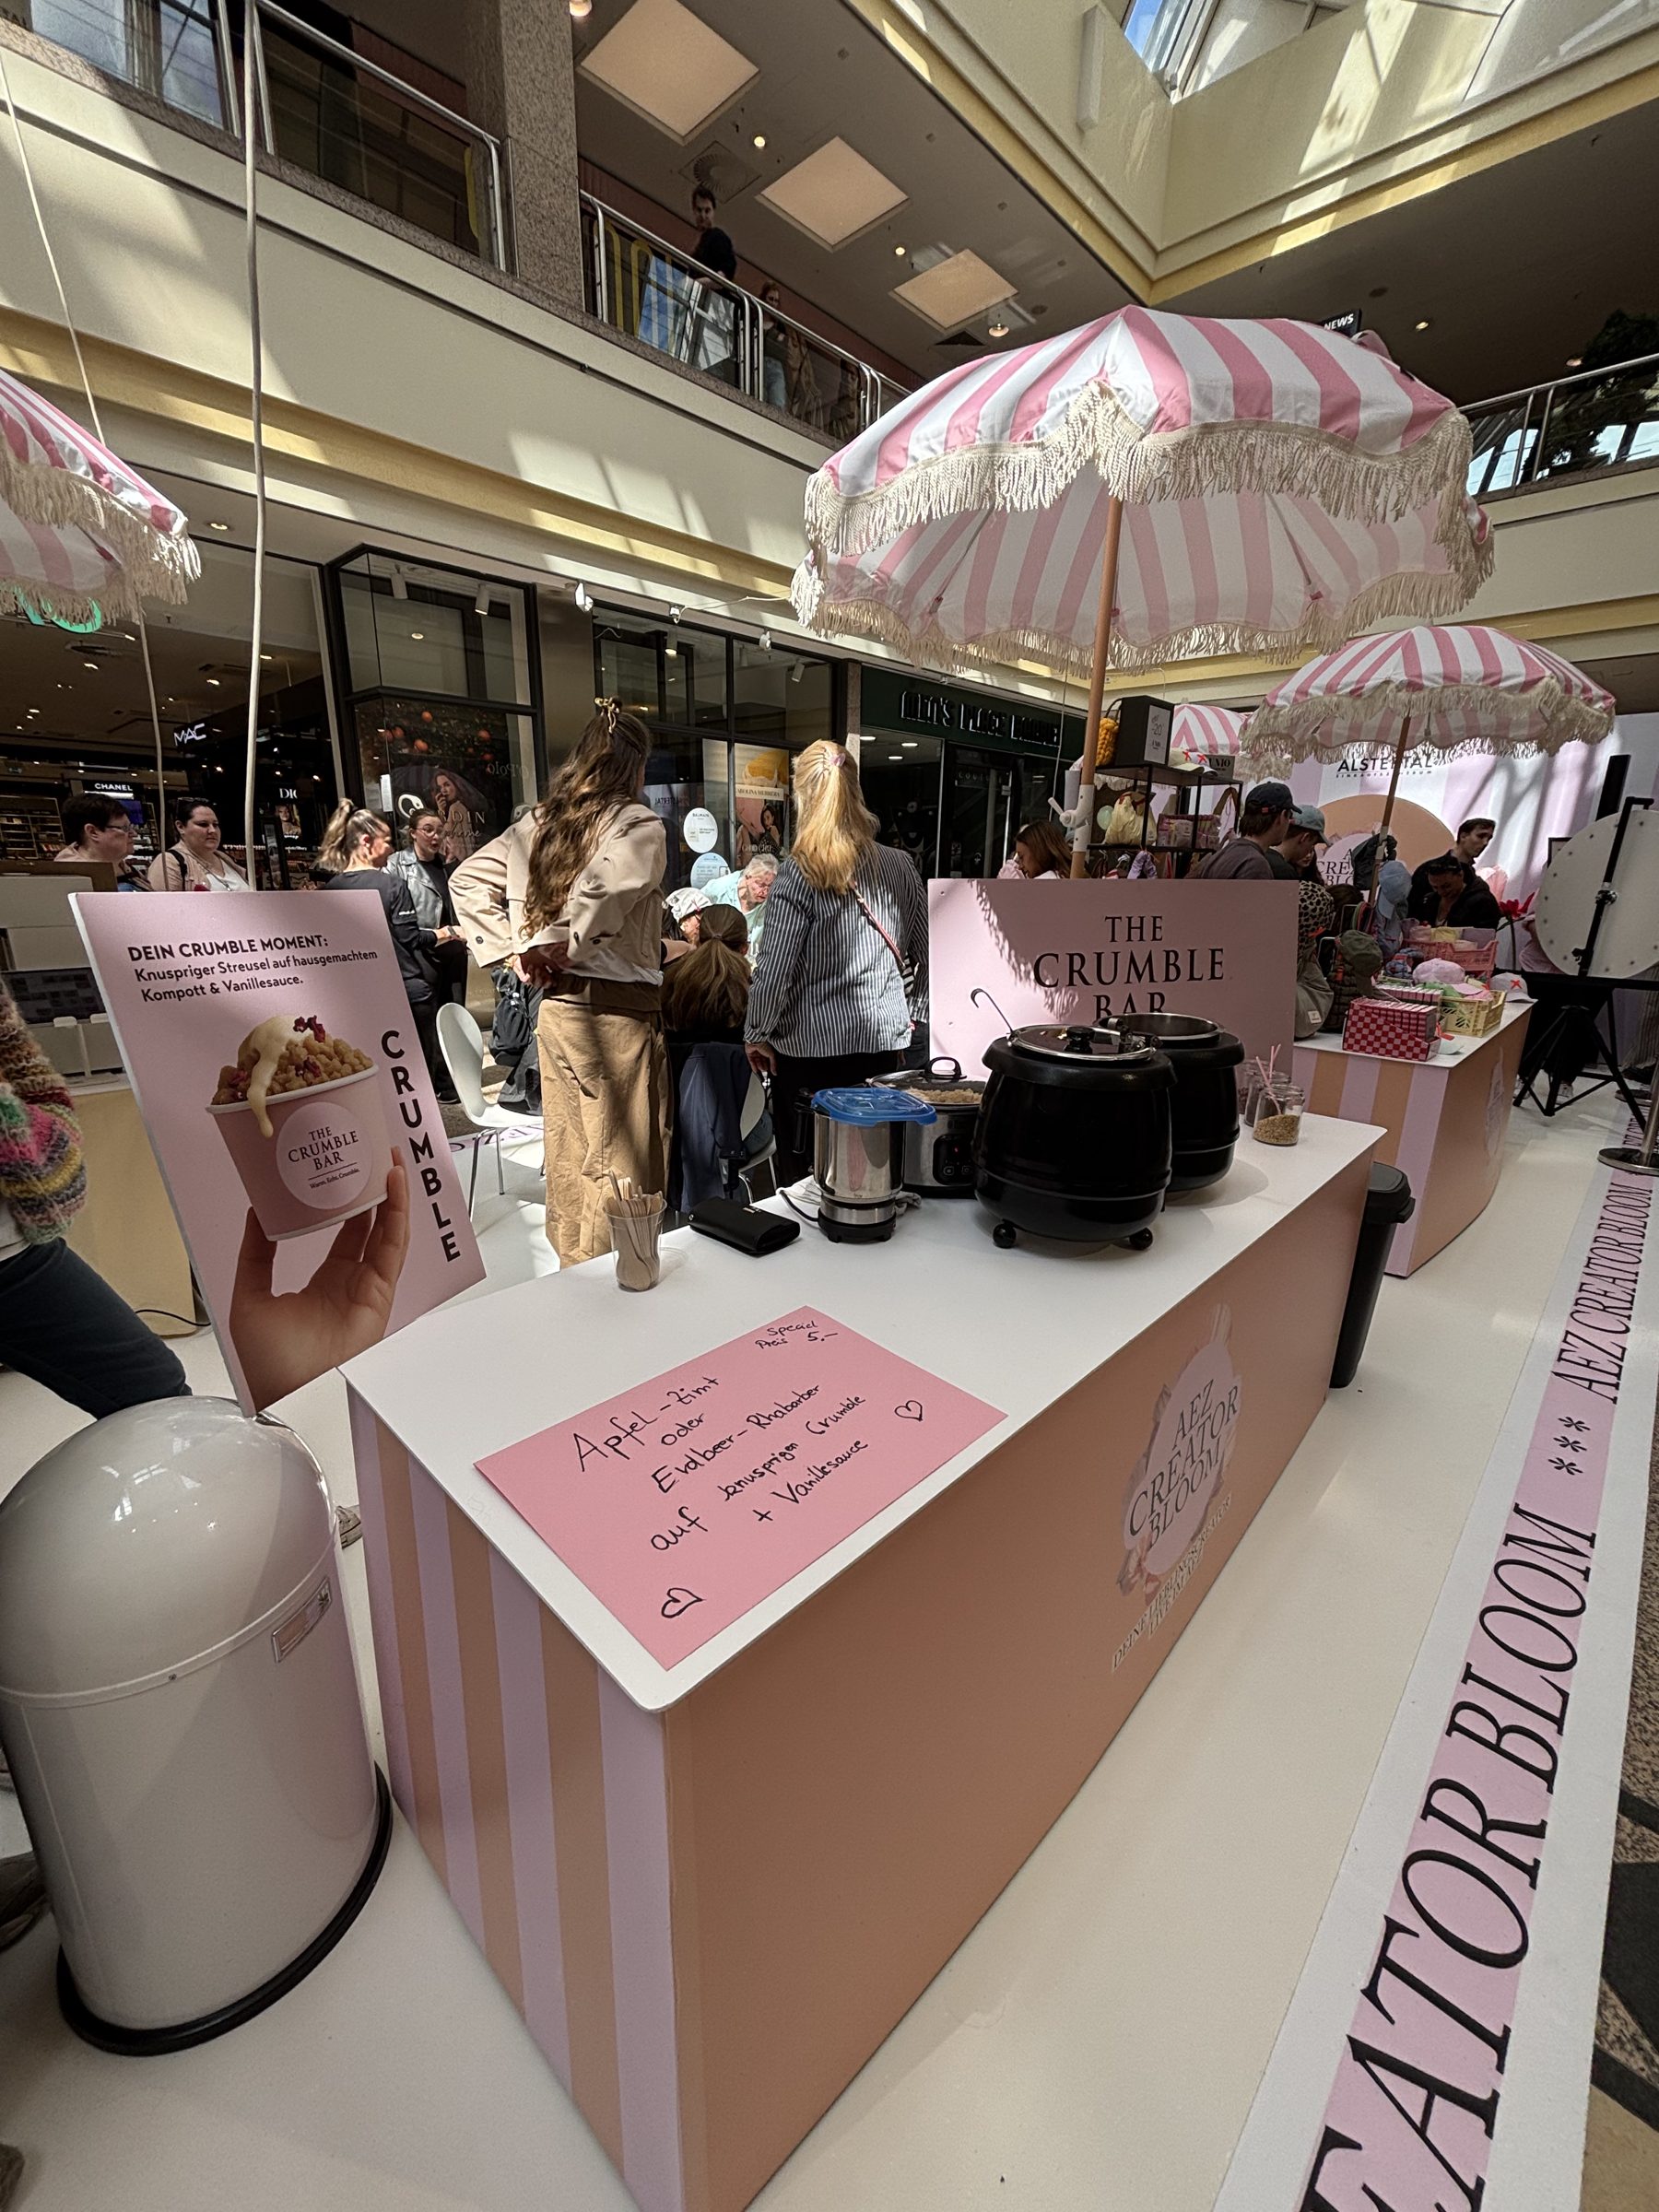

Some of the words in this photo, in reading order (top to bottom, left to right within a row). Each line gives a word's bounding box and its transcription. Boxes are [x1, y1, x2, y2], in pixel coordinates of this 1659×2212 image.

[94, 782, 133, 792] CHANEL
[127, 944, 175, 962] DEIN
[179, 938, 258, 959] CRUMBLE
[260, 934, 329, 951] MOMENT:
[1104, 915, 1163, 943] THE
[135, 963, 216, 982] Knuspriger
[218, 958, 271, 974] Streusel
[273, 956, 291, 969] auf
[292, 949, 378, 967] hausgemachtem
[1032, 947, 1225, 989] CRUMBLE
[141, 984, 207, 1003] Kompott
[209, 982, 220, 994] &
[222, 974, 304, 994] Vanillesauce.
[288, 1130, 359, 1163] CRUMBLE
[309, 1126, 333, 1142] THE
[381, 1030, 461, 1263] CRUMBLE
[313, 1151, 345, 1171] BAR
[1597, 1182, 1653, 1240] BLOOM
[1570, 1235, 1644, 1335] CREATOR
[1550, 1330, 1628, 1405] AEZ
[661, 1412, 705, 1446] oder
[1171, 1378, 1215, 1452] AEZ
[651, 1505, 709, 1551] auf
[806, 1394, 866, 1435] Crumble
[1129, 1385, 1239, 1536] CREATOR
[1148, 1436, 1221, 1549] BLOOM
[752, 1509, 773, 1523] +
[1445, 1501, 1596, 1794] BLOOM
